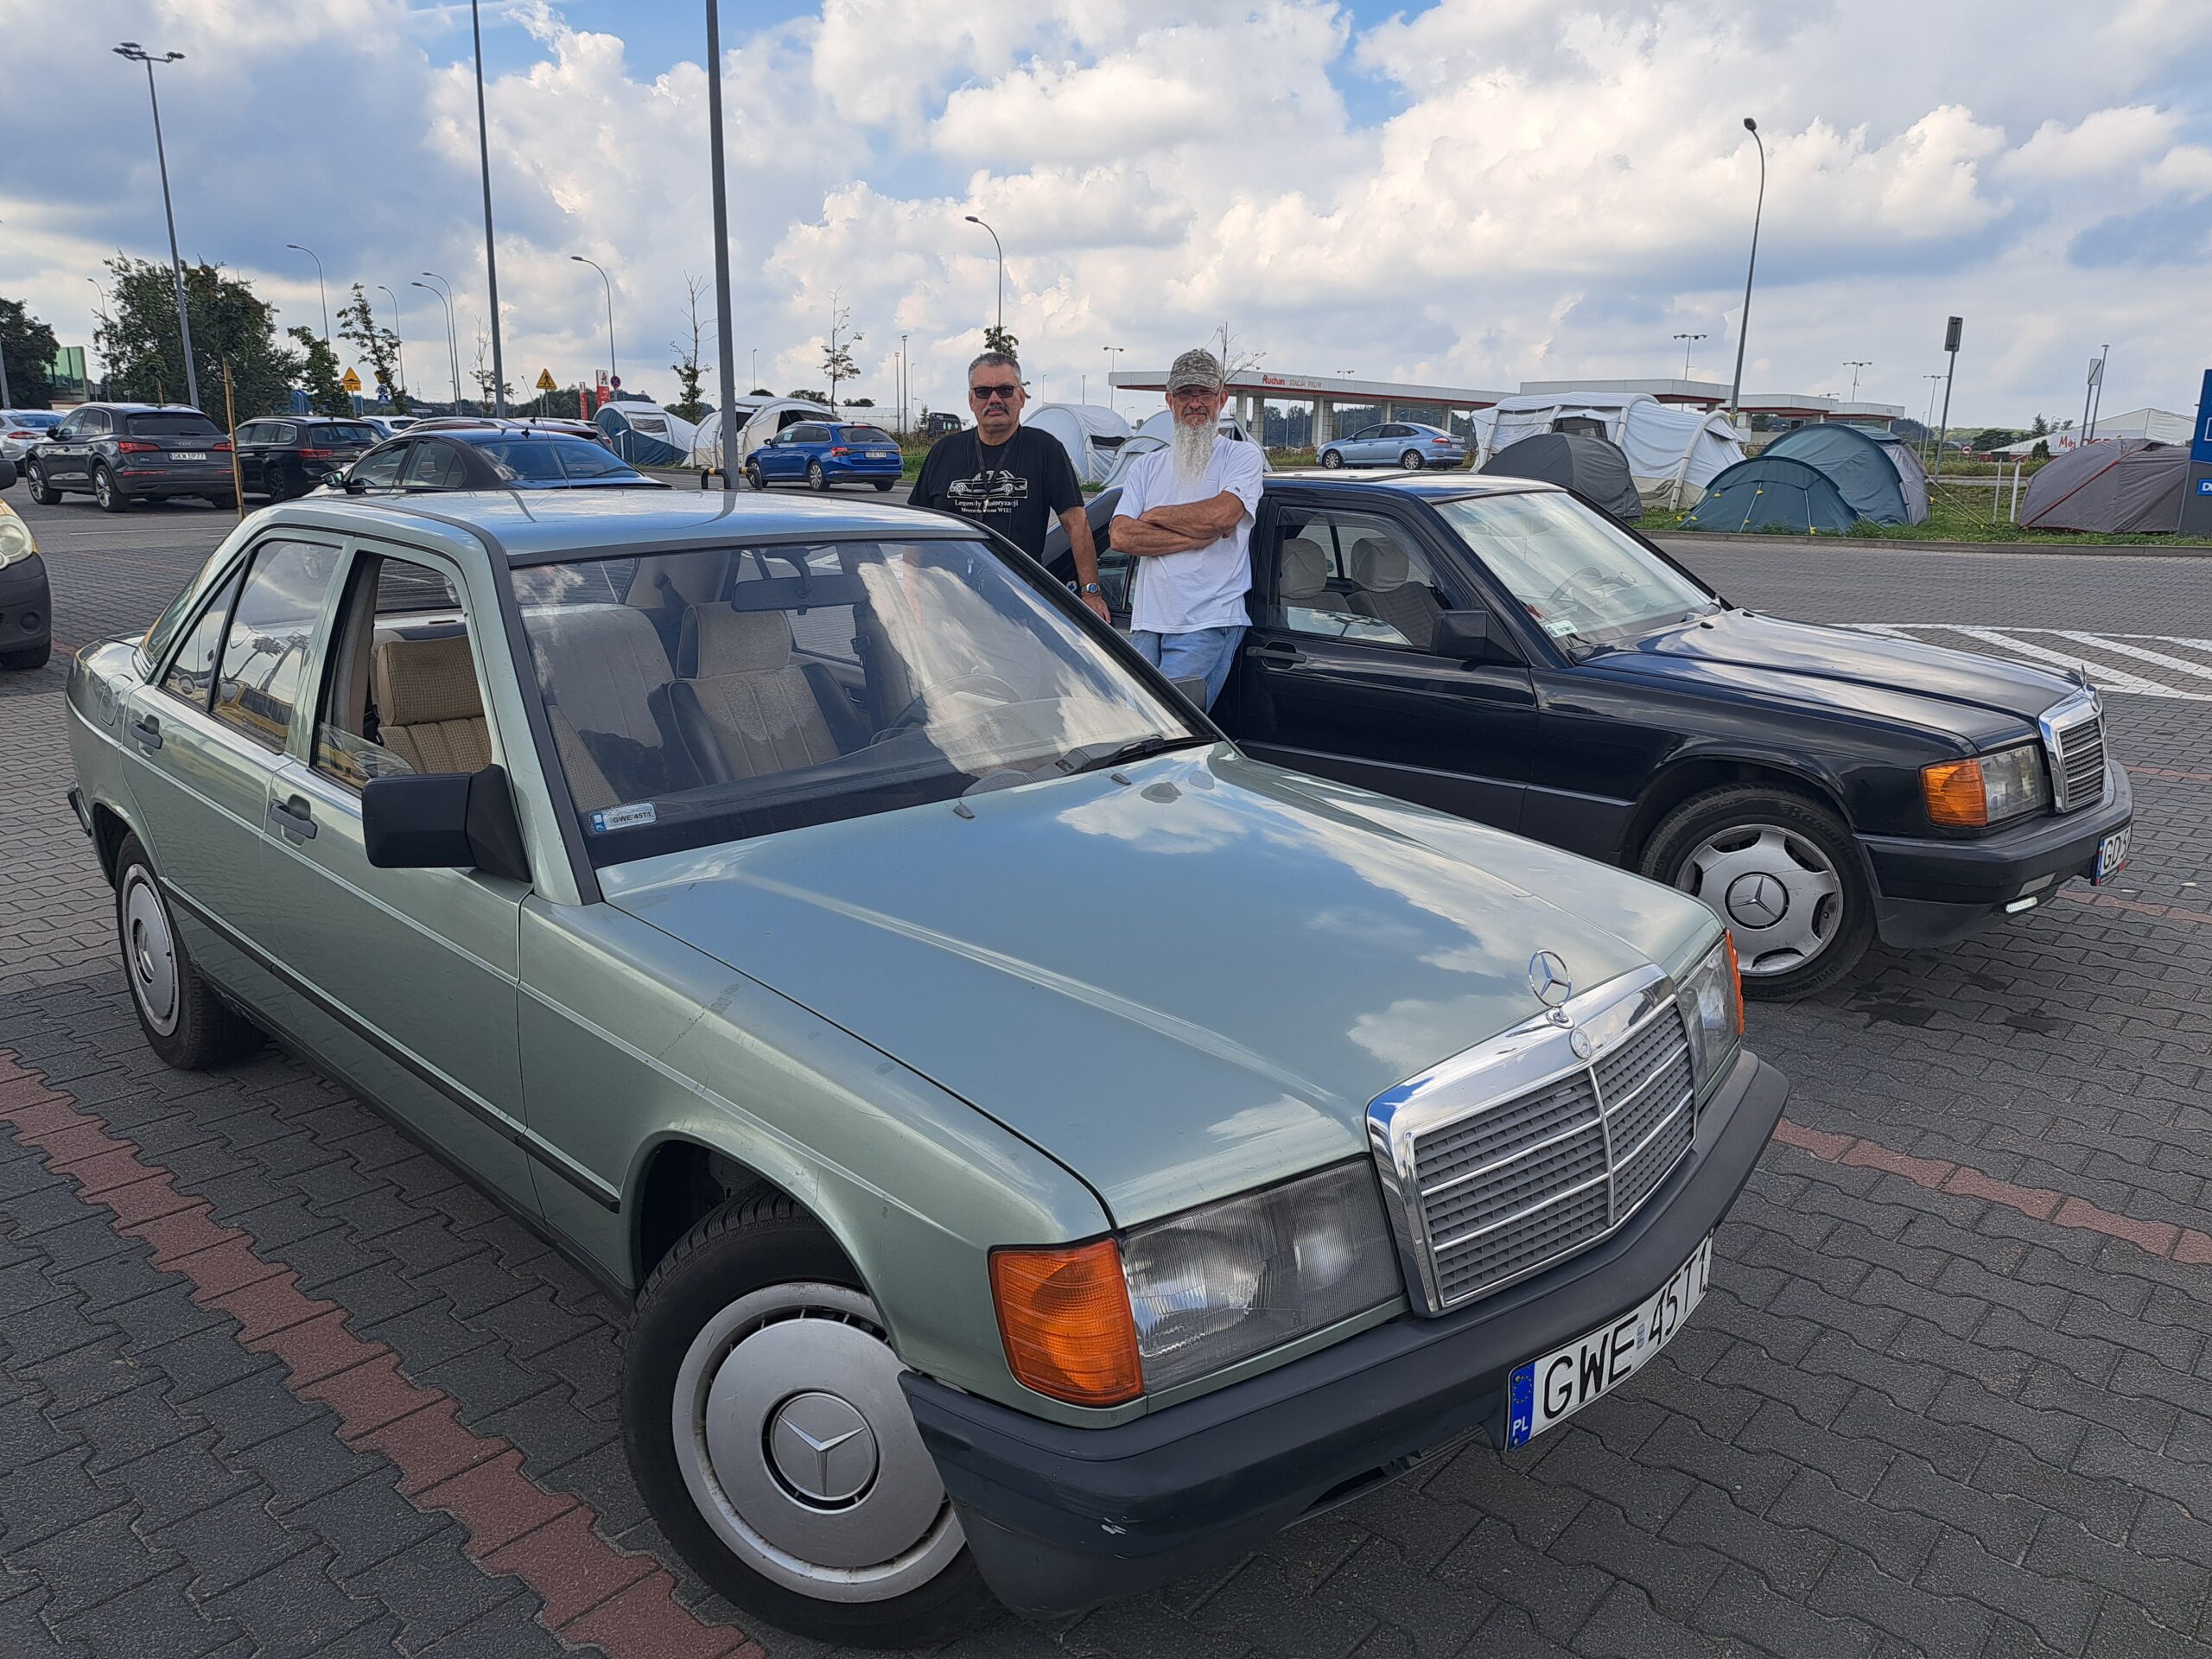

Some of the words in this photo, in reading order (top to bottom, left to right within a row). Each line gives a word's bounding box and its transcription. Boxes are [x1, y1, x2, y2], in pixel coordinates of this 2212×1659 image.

[1262, 374, 1285, 385] Auchan
[613, 815, 632, 823] GWE
[1542, 1313, 1639, 1421] GWE
[1647, 1240, 1707, 1346] 45T1
[1512, 1415, 1529, 1437] PL
